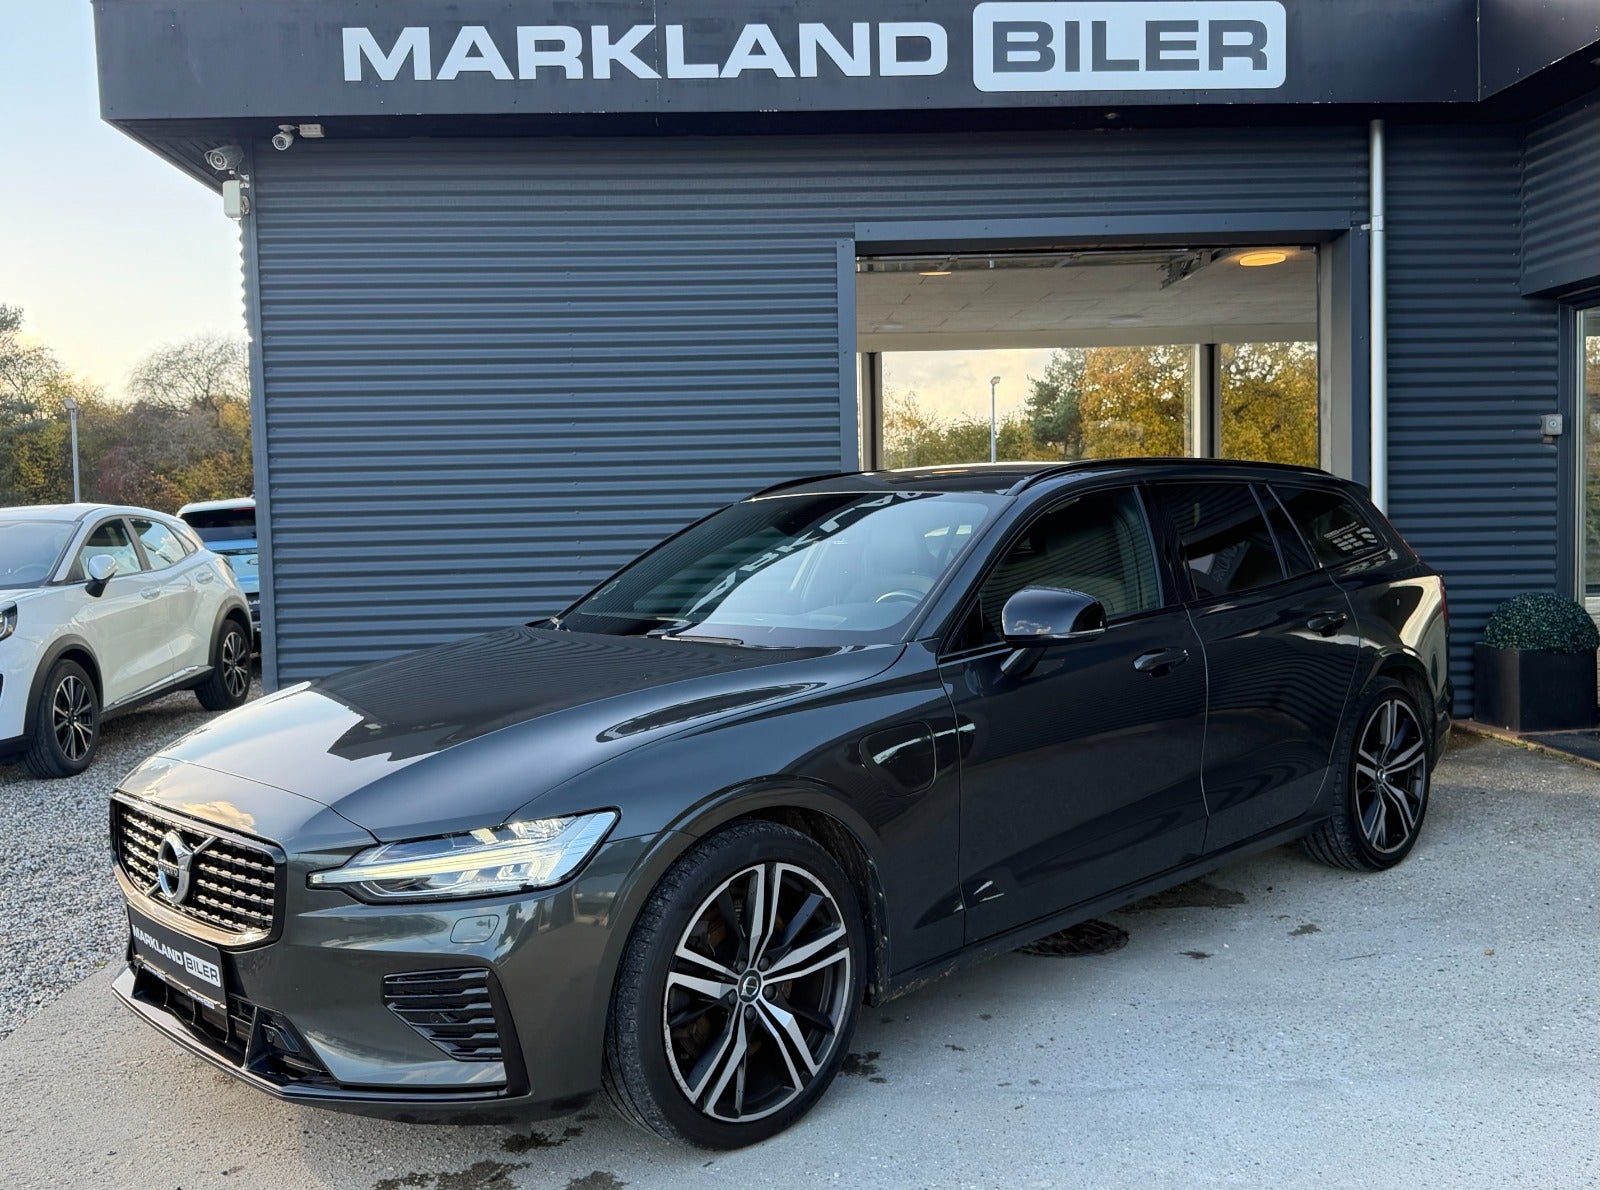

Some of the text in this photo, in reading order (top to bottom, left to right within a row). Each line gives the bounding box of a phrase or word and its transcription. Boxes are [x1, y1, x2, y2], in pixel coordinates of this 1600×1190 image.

[342, 20, 1268, 81] MARKLAND BILER
[132, 924, 183, 966] MARKLAND
[186, 957, 219, 982] BILER
